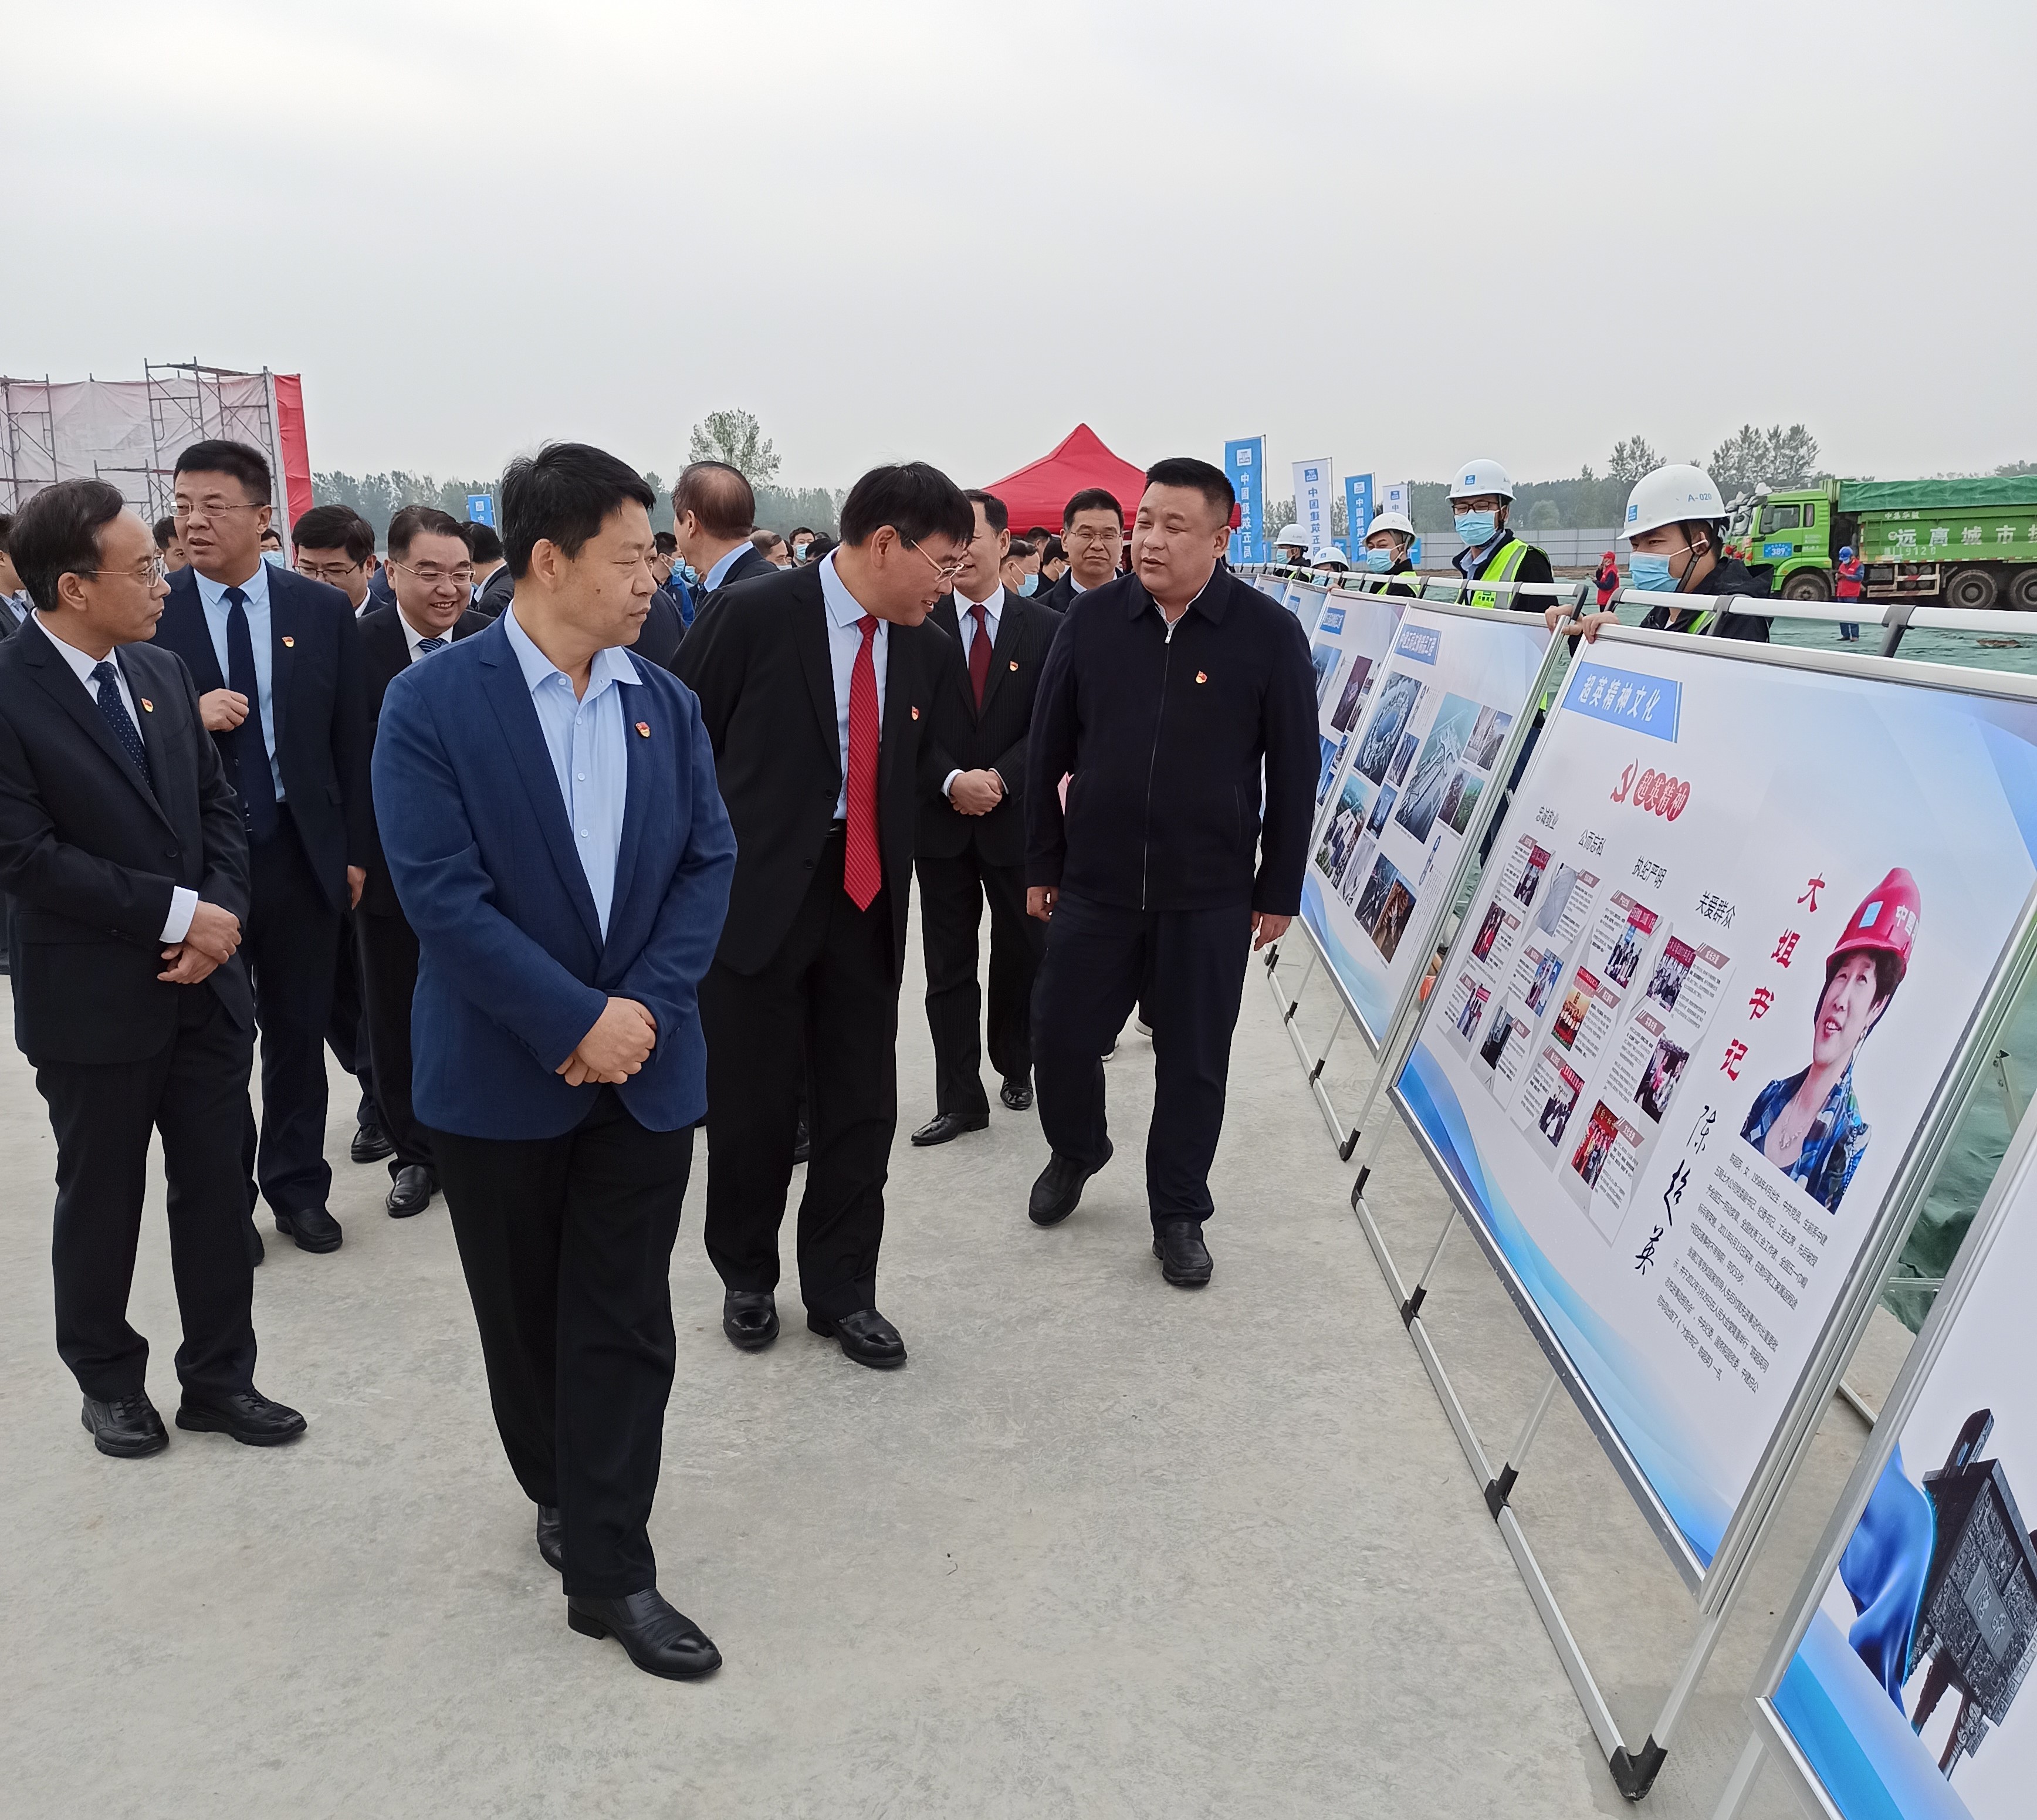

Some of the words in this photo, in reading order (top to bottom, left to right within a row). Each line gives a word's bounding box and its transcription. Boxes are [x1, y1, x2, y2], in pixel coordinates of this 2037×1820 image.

[1687, 493, 1712, 502] A-020
[1578, 674, 1661, 722] 超英精神文化
[1636, 772, 1687, 818] 超英精神
[1535, 806, 1559, 830] 忠诚敬业
[1578, 828, 1607, 857] 公而忘私
[1632, 856, 1667, 890] 执纪严明
[1696, 891, 1737, 929] 关爱群众
[1720, 872, 1826, 1081] 大姐书记
